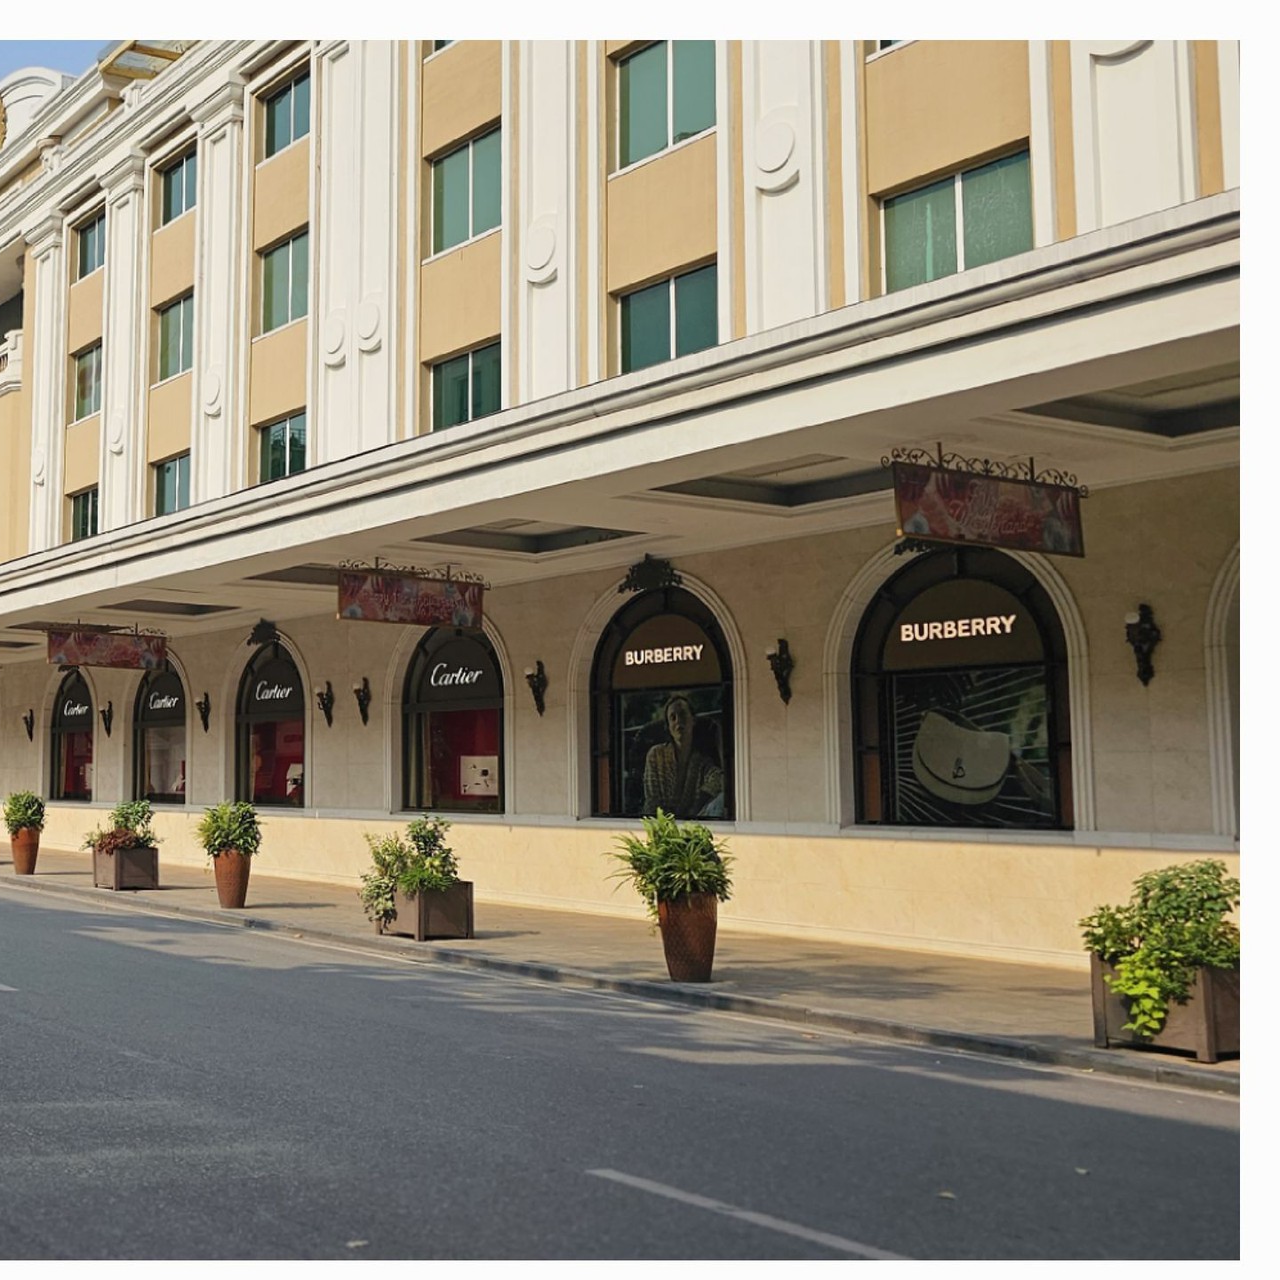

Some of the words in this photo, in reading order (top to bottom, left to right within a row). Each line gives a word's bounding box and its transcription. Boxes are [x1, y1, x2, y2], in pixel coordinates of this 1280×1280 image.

[900, 615, 1016, 642] BURBERRY
[625, 645, 704, 666] BURBERRY
[430, 663, 483, 687] Cartier
[256, 680, 293, 700] Cartier
[63, 700, 89, 716] Cartier
[149, 692, 179, 710] Cartier
